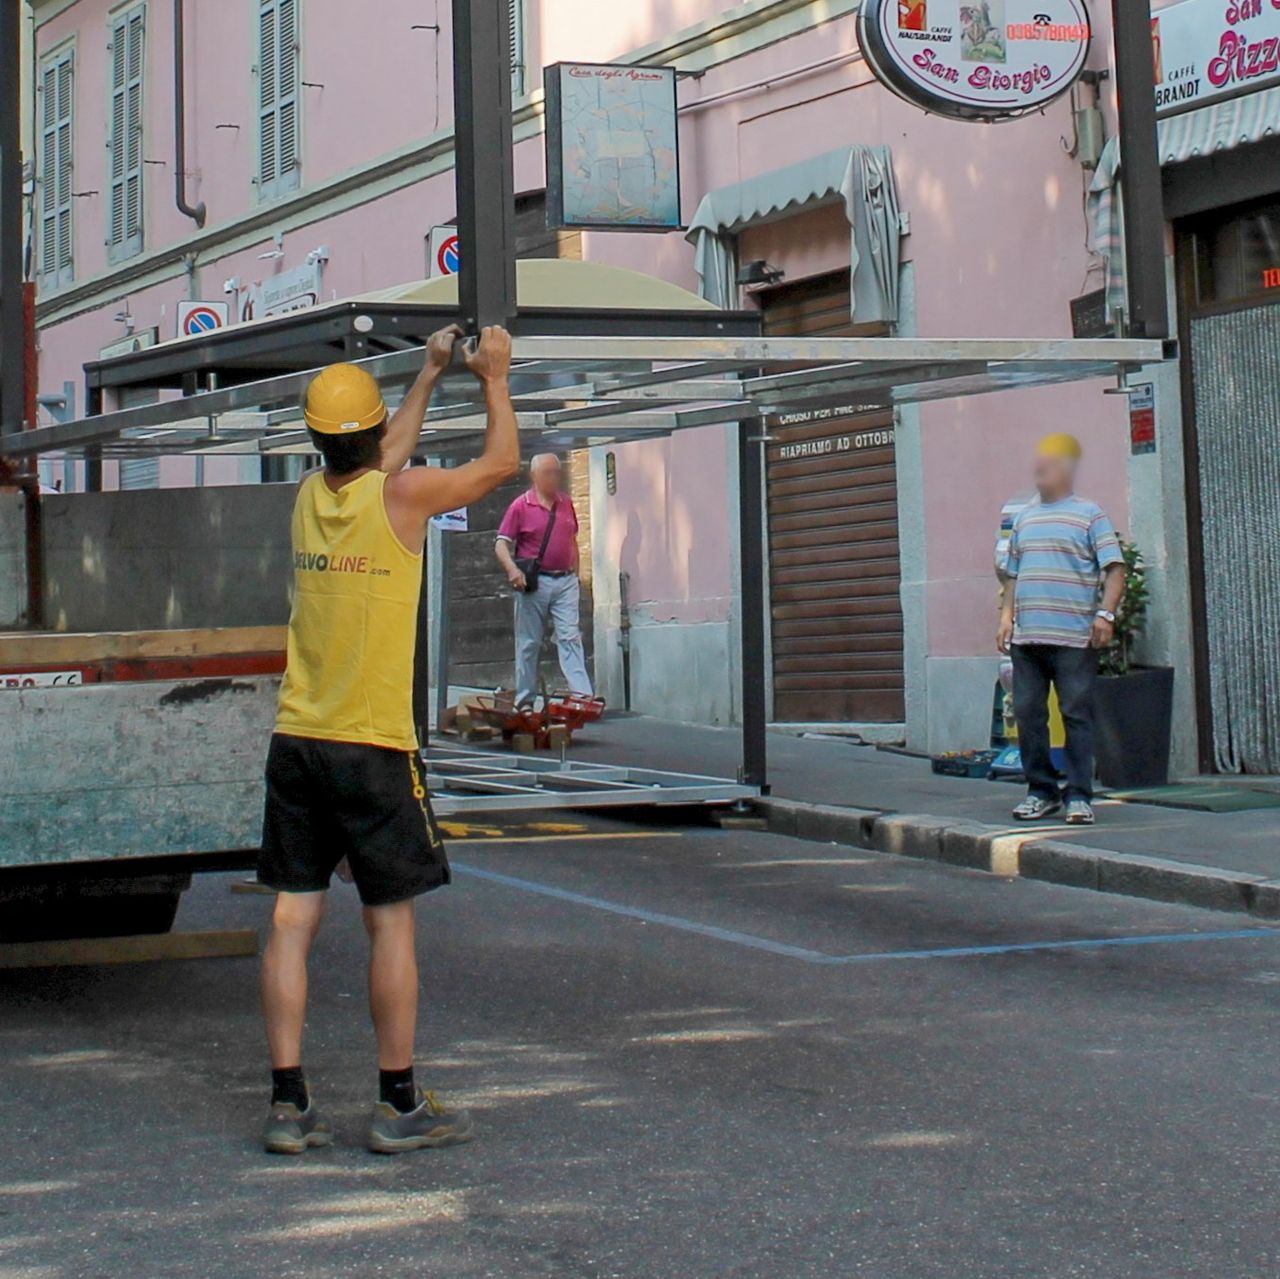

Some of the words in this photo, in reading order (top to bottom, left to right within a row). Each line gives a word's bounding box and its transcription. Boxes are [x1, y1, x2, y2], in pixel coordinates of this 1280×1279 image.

[898, 31, 953, 42] HAUSBRANDT
[913, 48, 960, 84] San
[968, 63, 1052, 95] Giorgio
[780, 440, 832, 459] RIAPRIAMO
[836, 437, 850, 451] AD
